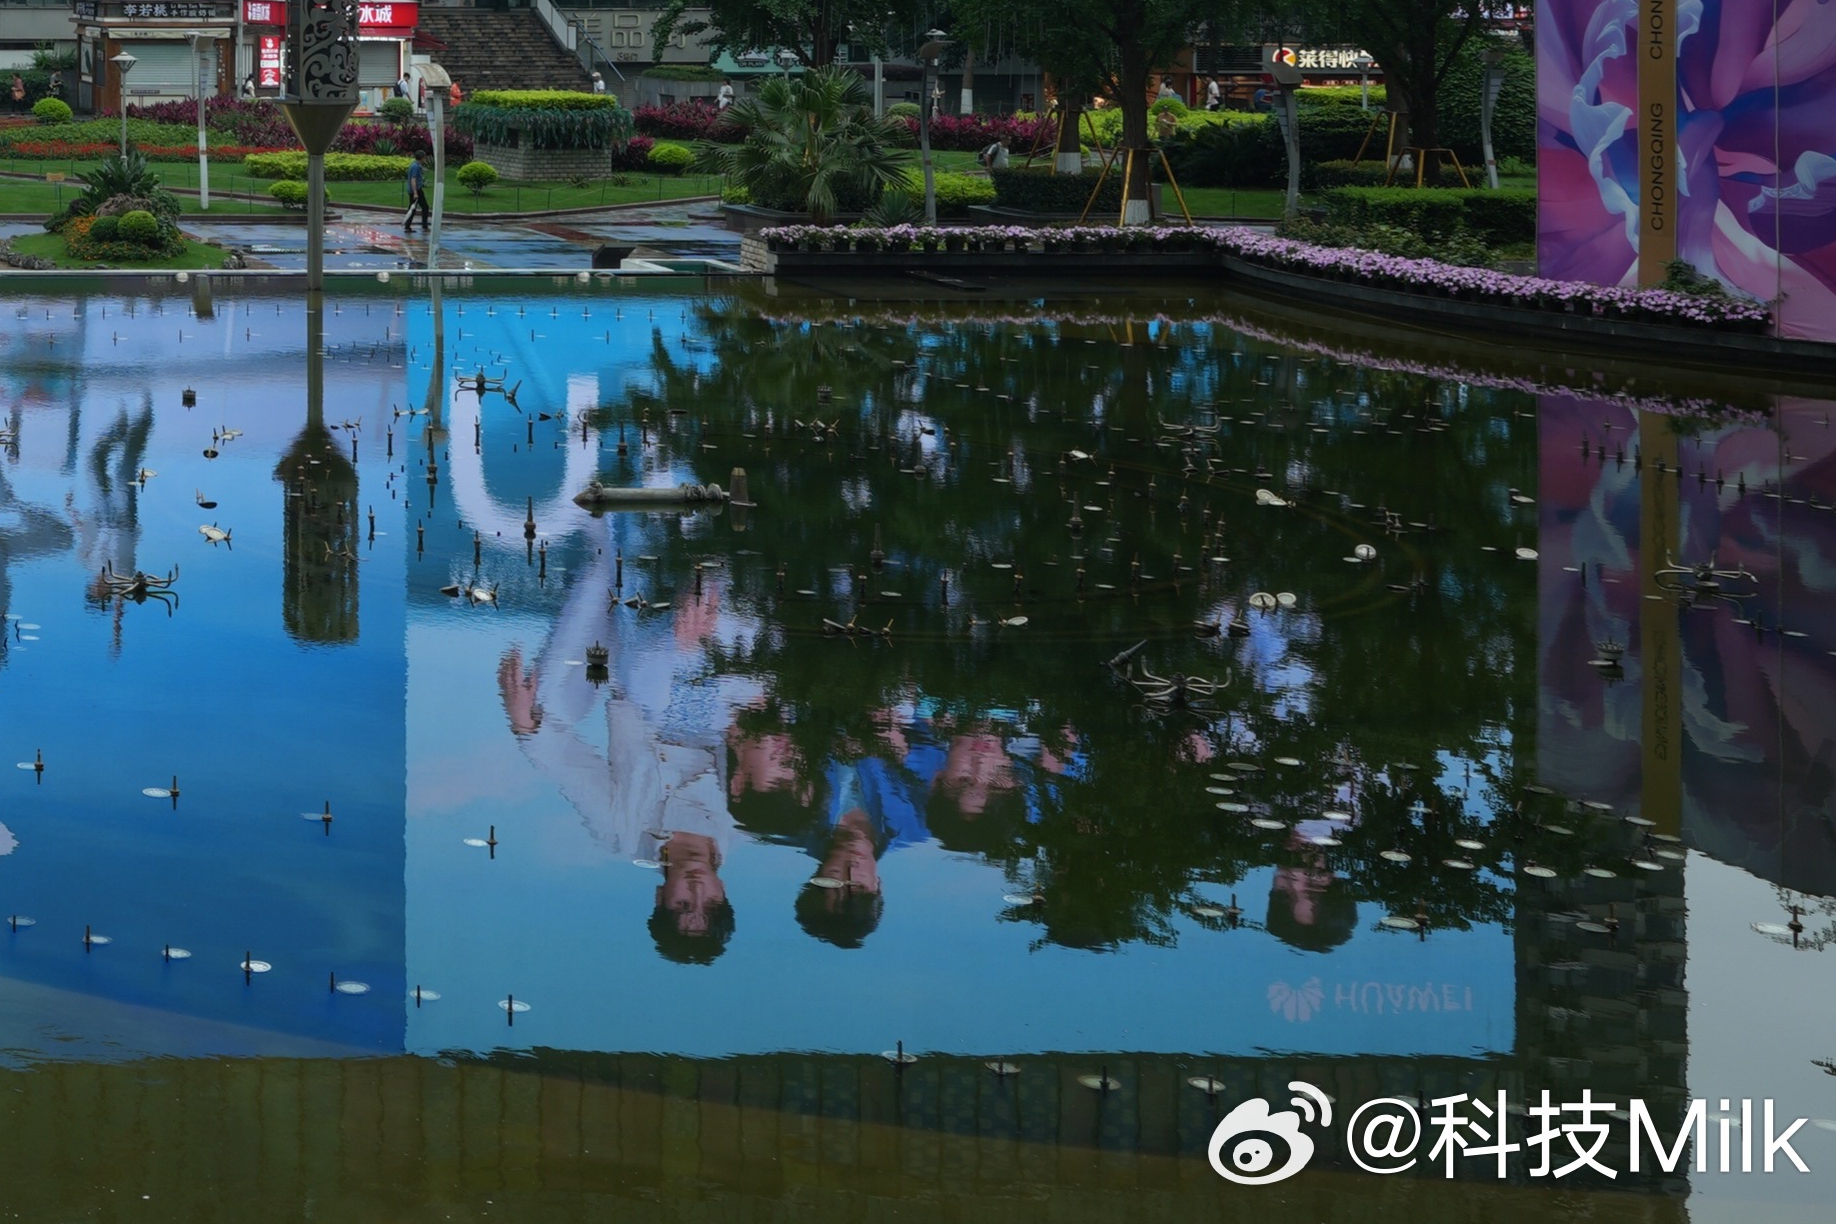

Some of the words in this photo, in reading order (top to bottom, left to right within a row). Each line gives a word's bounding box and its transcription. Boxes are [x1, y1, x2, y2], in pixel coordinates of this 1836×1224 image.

[123, 3, 168, 17] 李若桃
[1650, 103, 1663, 231] CHONGQING
